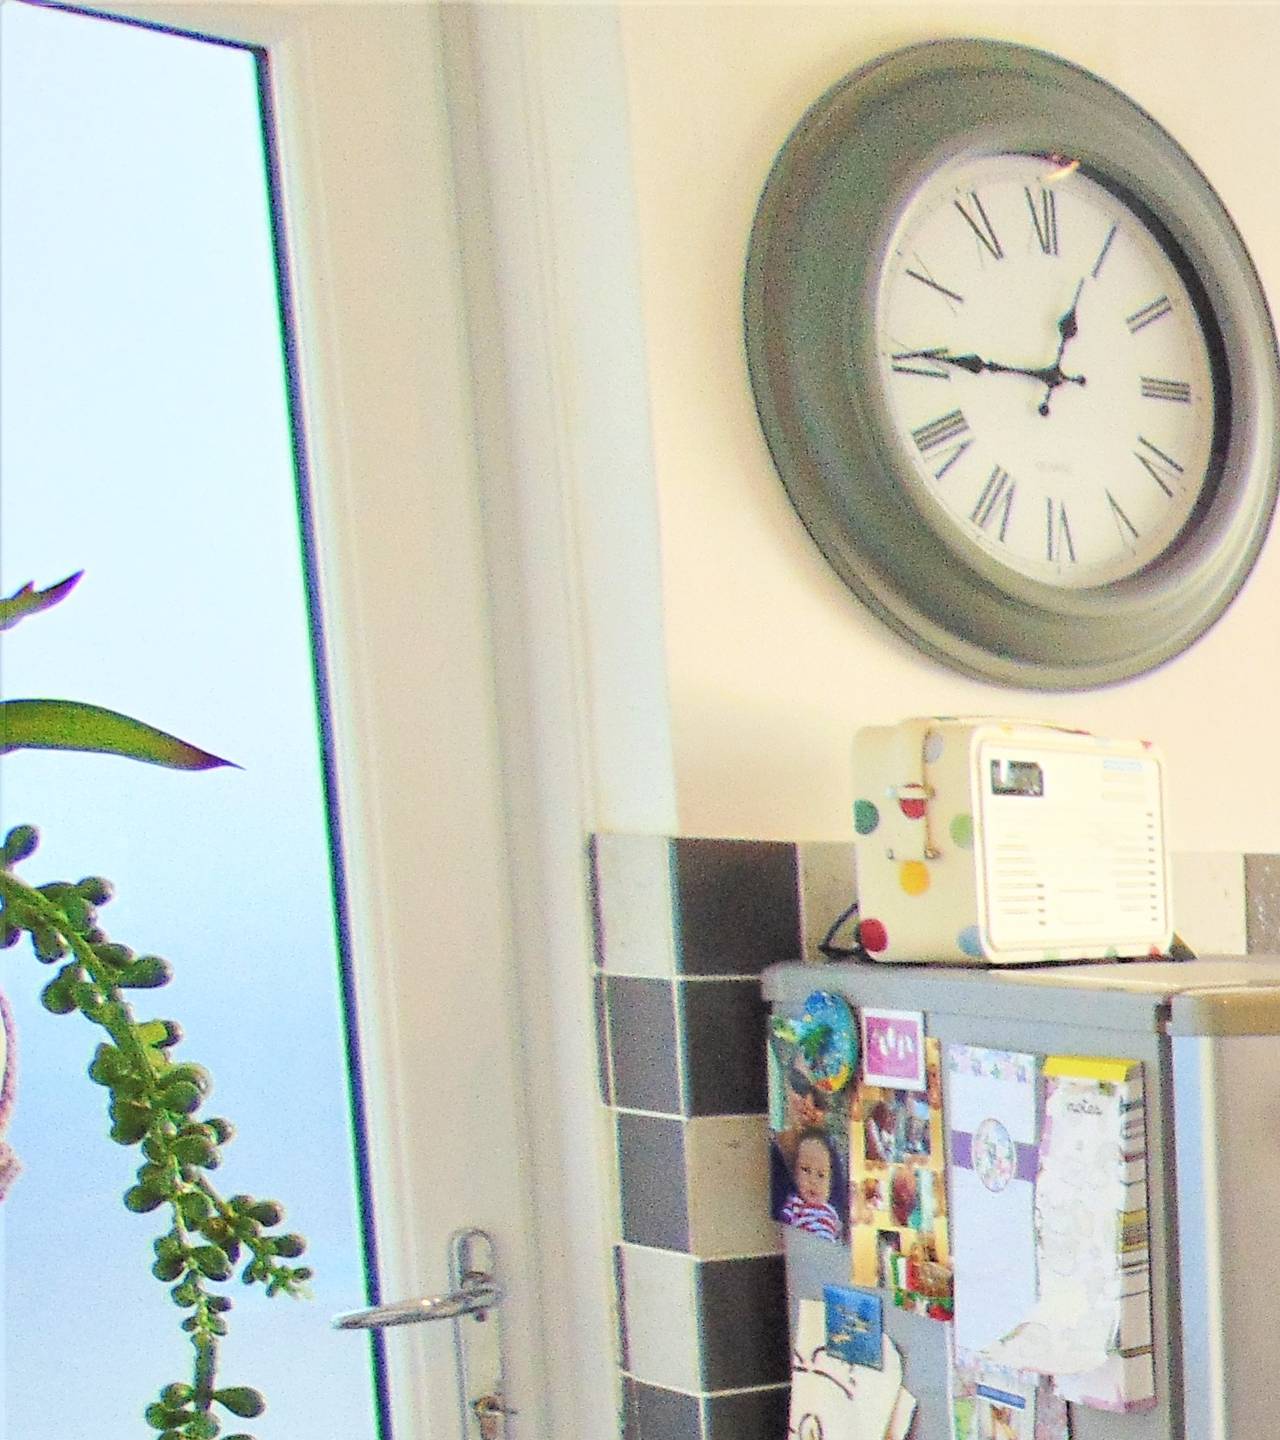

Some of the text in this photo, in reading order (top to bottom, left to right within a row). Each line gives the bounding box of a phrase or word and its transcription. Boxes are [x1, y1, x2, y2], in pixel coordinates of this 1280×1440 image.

[1024, 186, 1058, 256] XII
[1091, 222, 1118, 279] I
[1126, 295, 1173, 335] II
[1140, 375, 1192, 403] III
